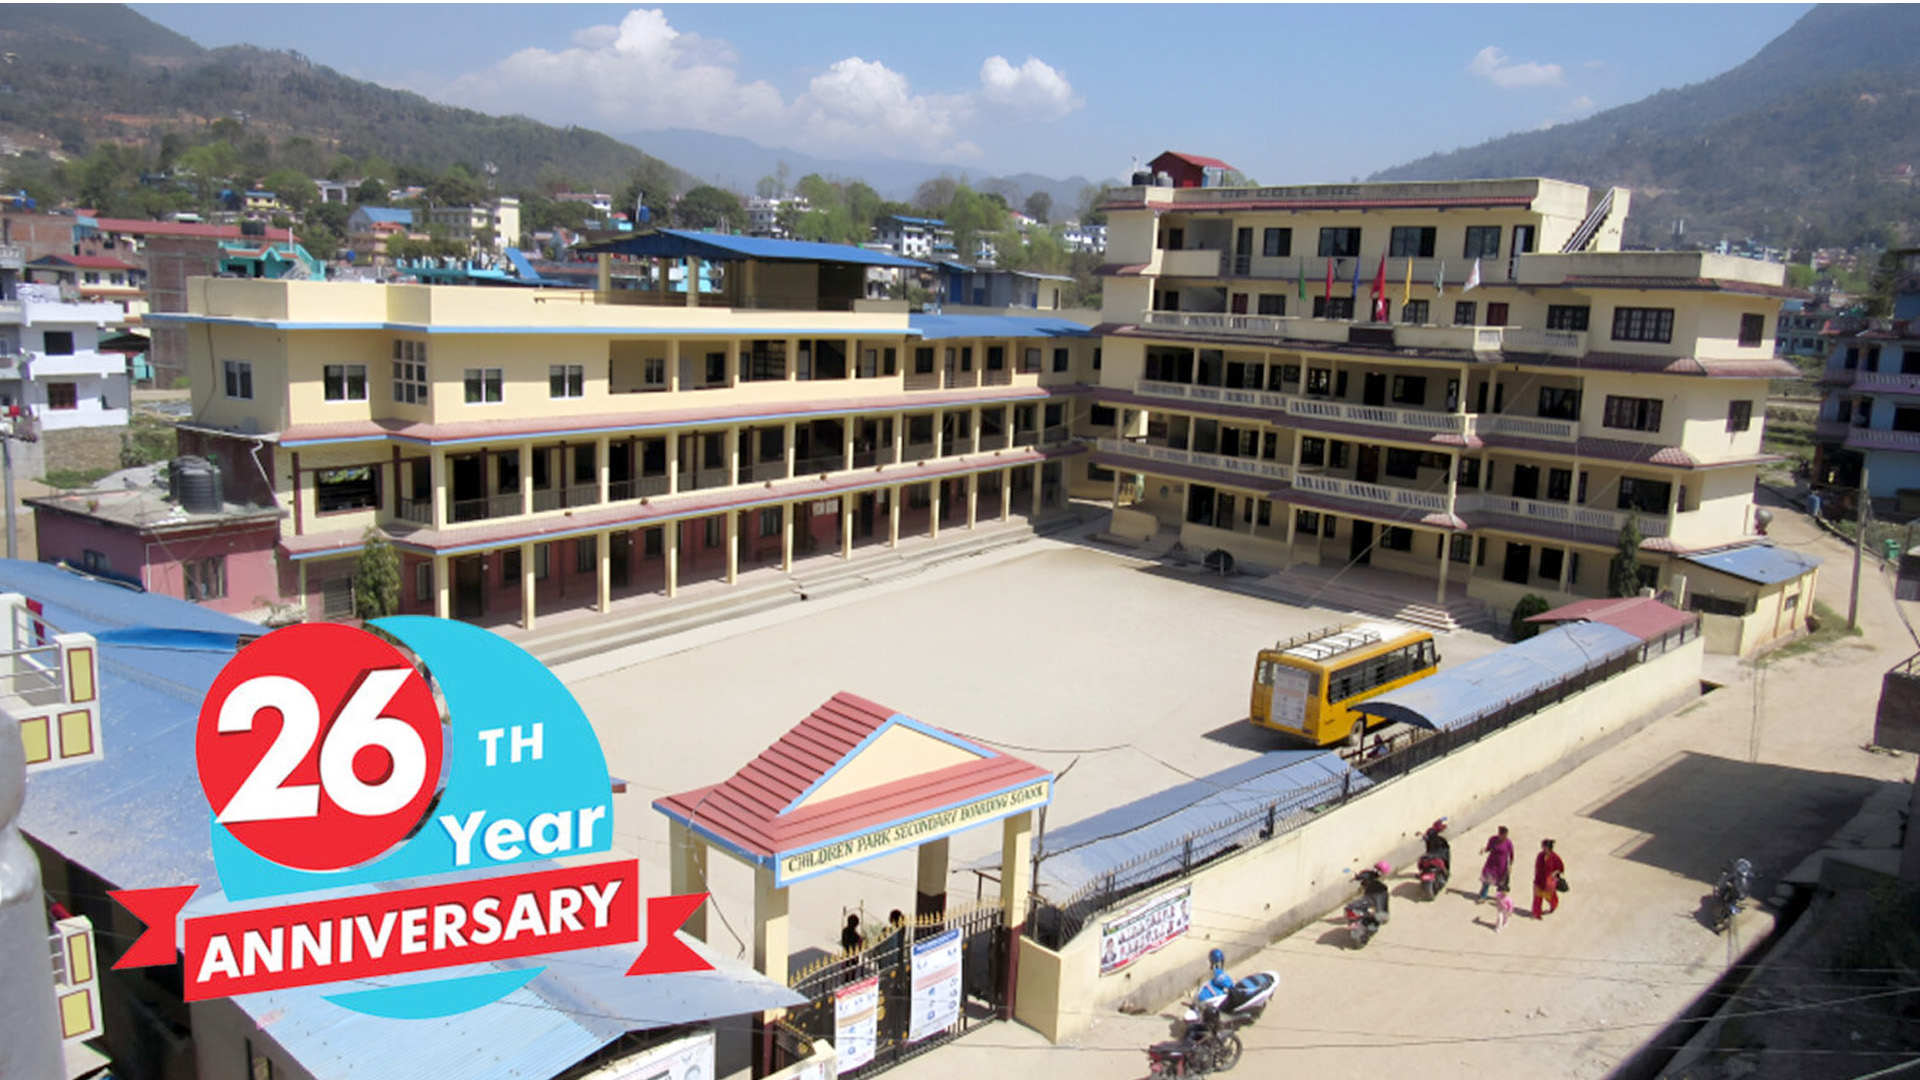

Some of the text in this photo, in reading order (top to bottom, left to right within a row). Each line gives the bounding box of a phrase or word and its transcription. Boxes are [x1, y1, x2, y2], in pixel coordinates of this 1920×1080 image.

[788, 840, 854, 872] CHILDREN
[856, 829, 891, 852] PARK
[893, 809, 958, 841] SECONDARY
